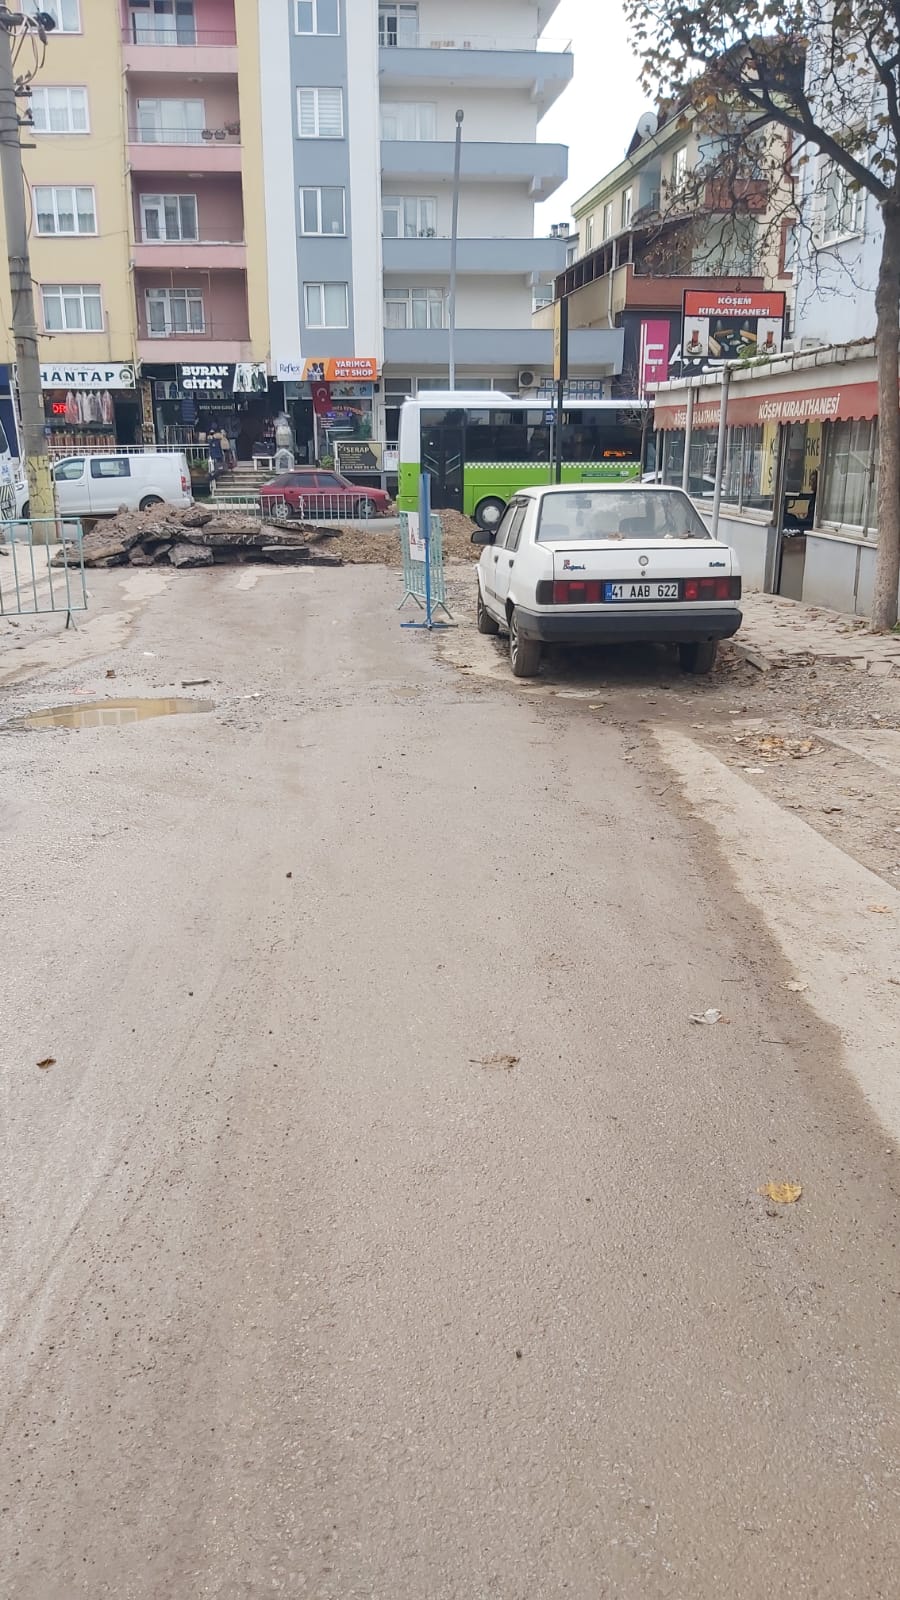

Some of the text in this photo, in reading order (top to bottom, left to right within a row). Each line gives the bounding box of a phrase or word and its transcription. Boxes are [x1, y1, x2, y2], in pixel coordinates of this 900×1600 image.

[718, 296, 751, 306] KÖŞEM
[698, 307, 769, 316] KIRAATHANESİ
[280, 363, 300, 373] Reflex
[336, 360, 371, 368] YARIMCA
[181, 366, 229, 376] BURAK
[335, 369, 373, 377] PET SHOP
[182, 376, 222, 389] GİYİM
[758, 392, 840, 421] KÖŞEM KIRAATHANESİ
[612, 584, 677, 598] 41 AAB 622
